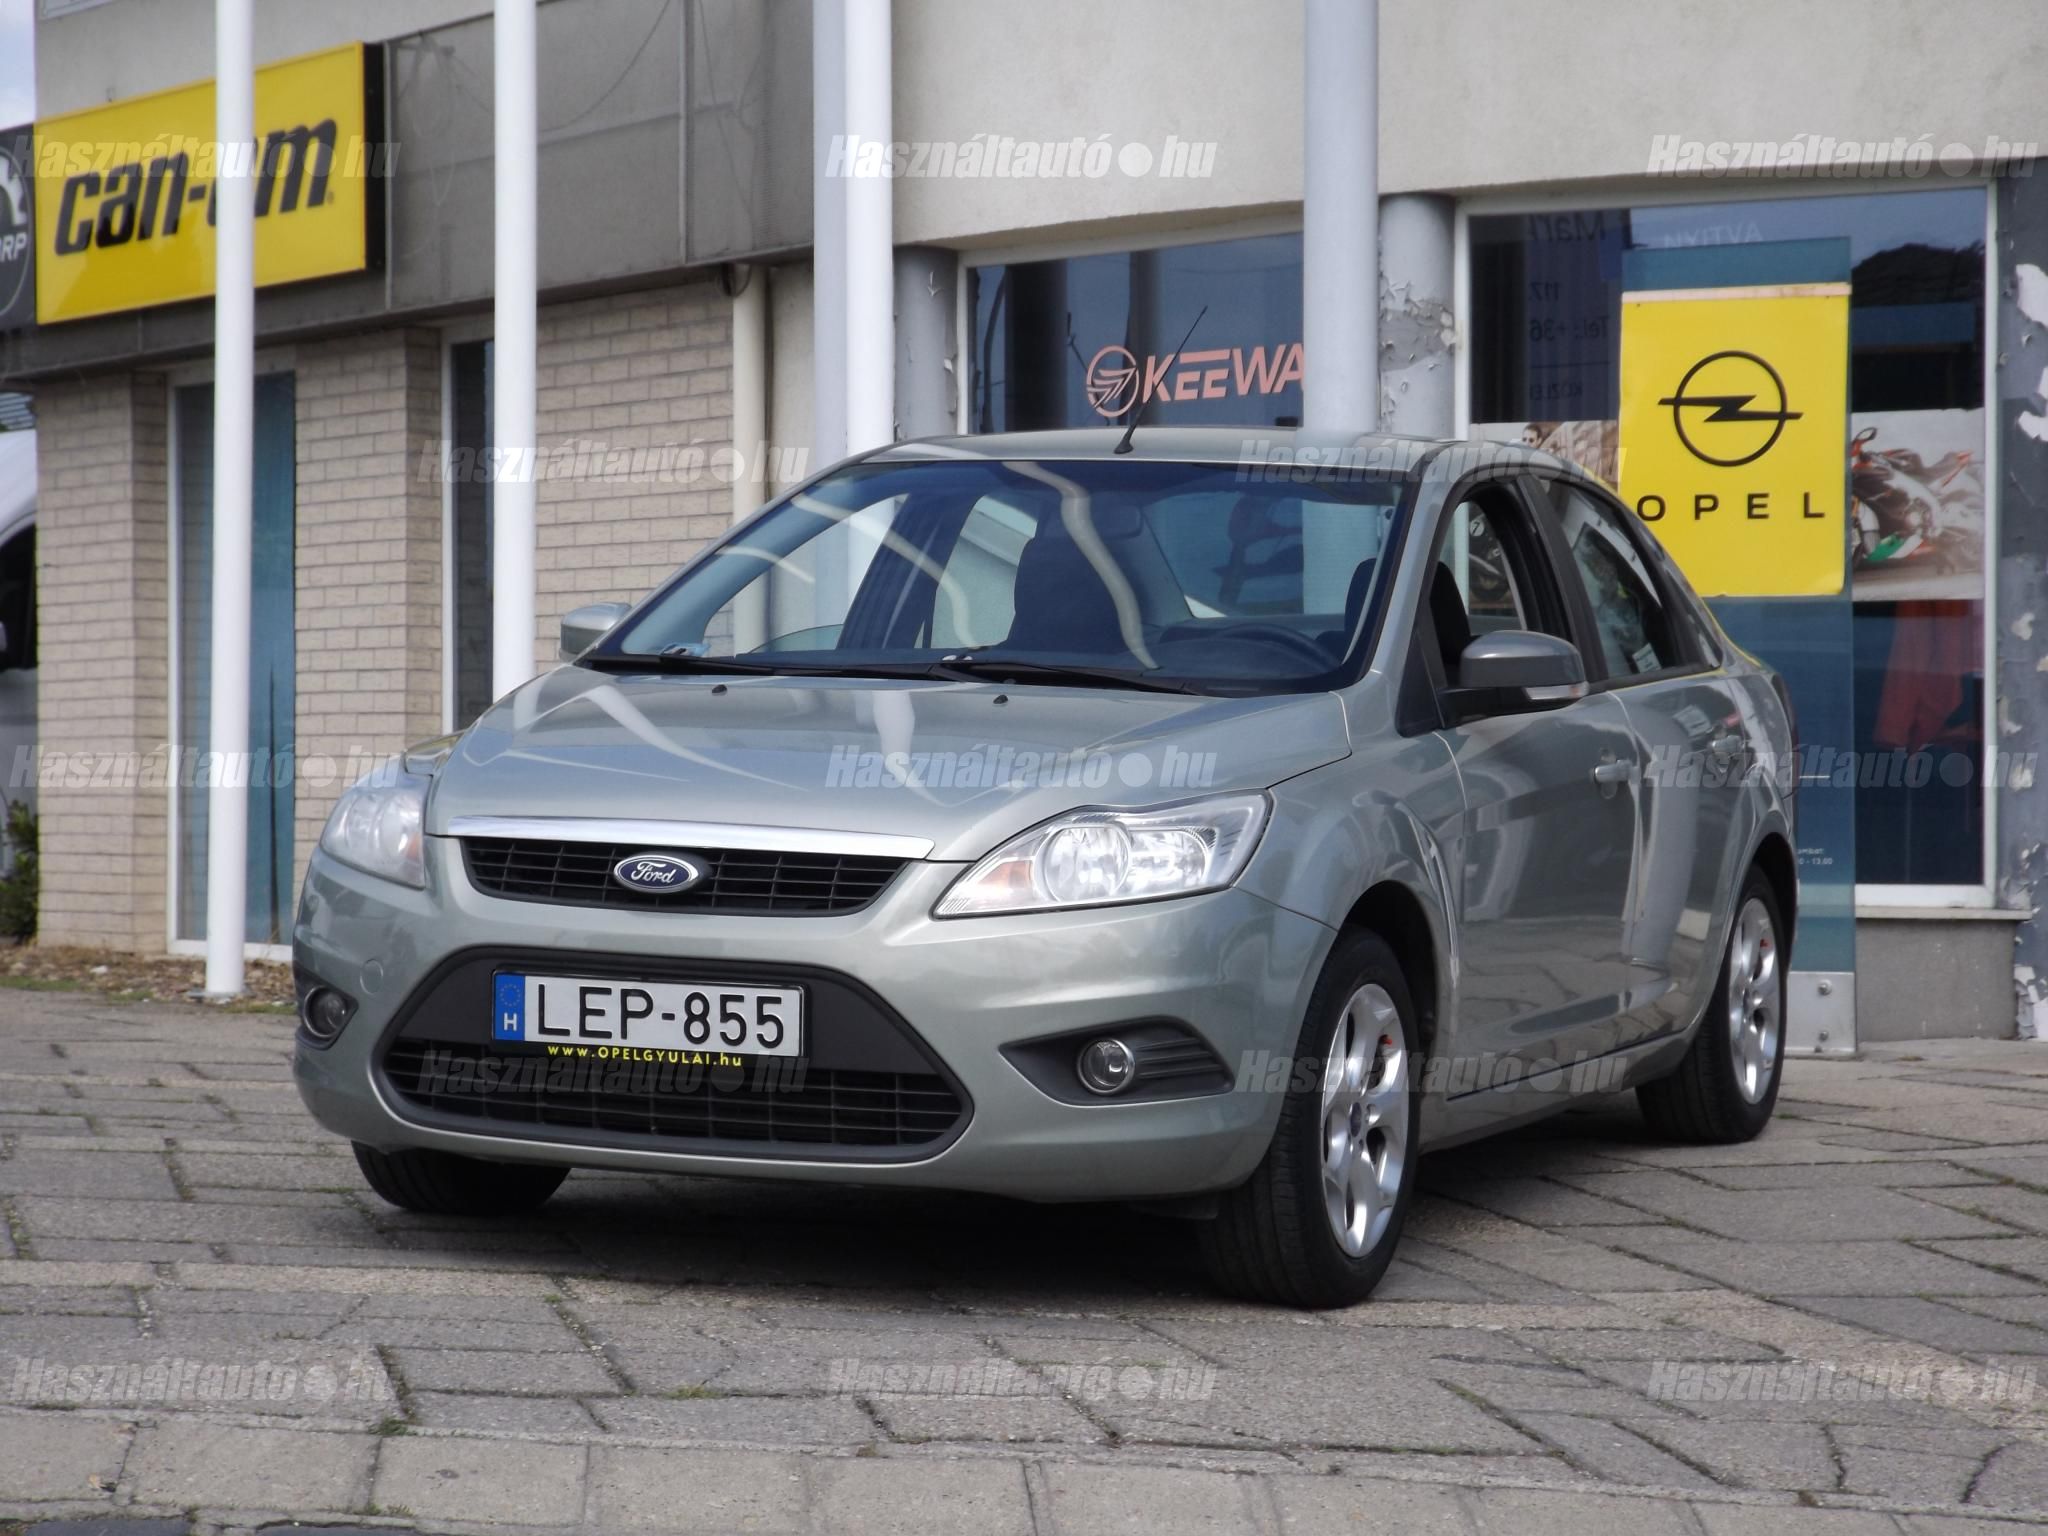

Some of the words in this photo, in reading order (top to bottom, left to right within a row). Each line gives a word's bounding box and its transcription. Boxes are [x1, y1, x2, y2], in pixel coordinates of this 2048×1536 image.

[55, 119, 337, 256] can-m
[0, 232, 27, 263] RP
[1637, 492, 1825, 521] OPEL
[631, 861, 677, 884] Ford
[503, 1012, 517, 1032] H
[538, 983, 784, 1049] LEP-855
